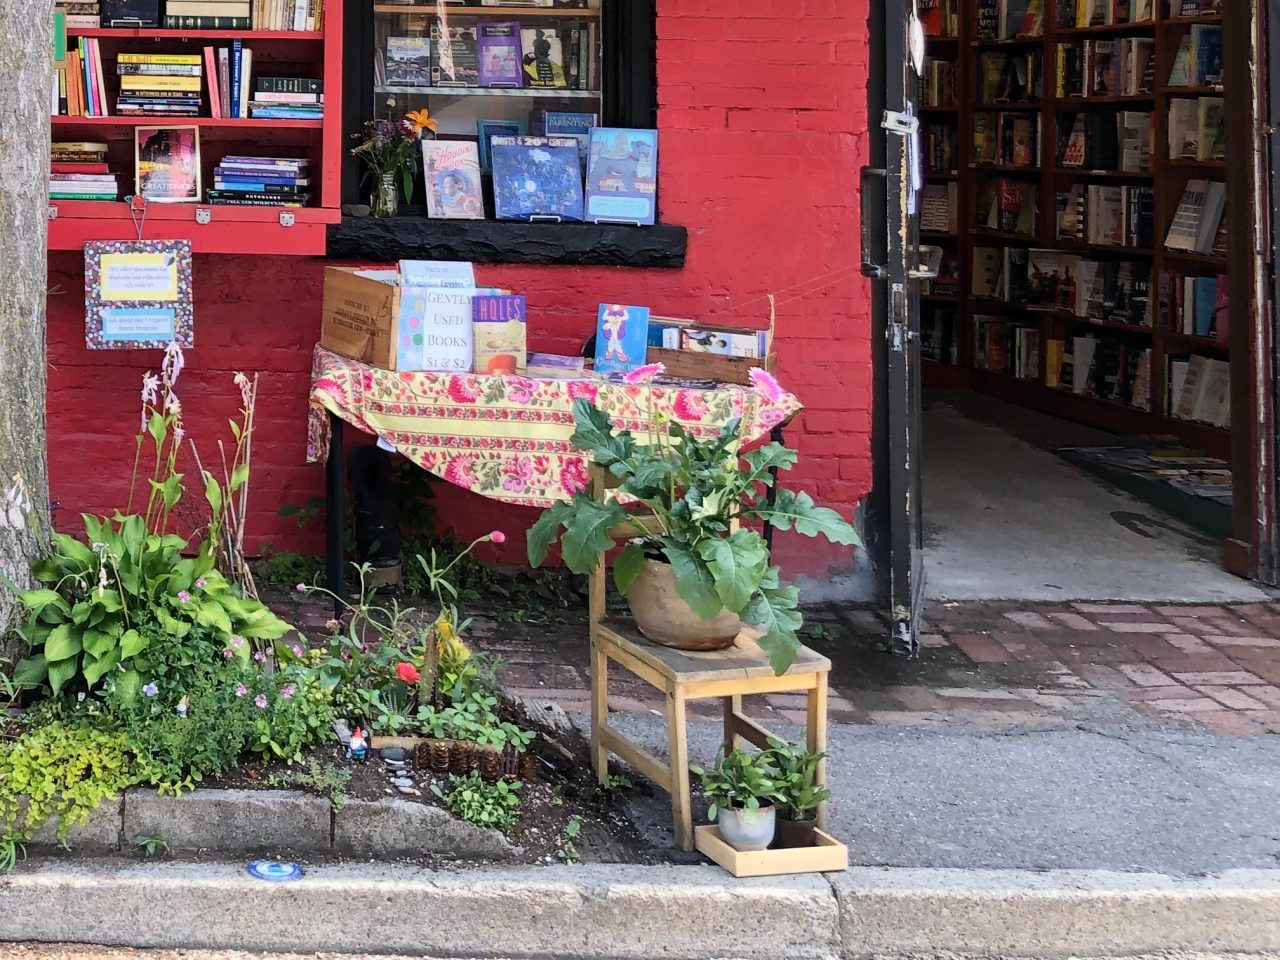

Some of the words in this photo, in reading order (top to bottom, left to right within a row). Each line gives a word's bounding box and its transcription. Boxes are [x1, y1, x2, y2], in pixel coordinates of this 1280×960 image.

[548, 119, 593, 128] PARENTING
[440, 140, 473, 163] HOUDINI
[140, 182, 166, 190] GREAT
[427, 291, 472, 305] GENTLY
[479, 297, 521, 322] HOLES
[433, 313, 464, 326] USED
[427, 335, 468, 348] BOOKS
[426, 357, 438, 368] $1
[440, 357, 451, 368] &
[452, 357, 466, 369] $2
